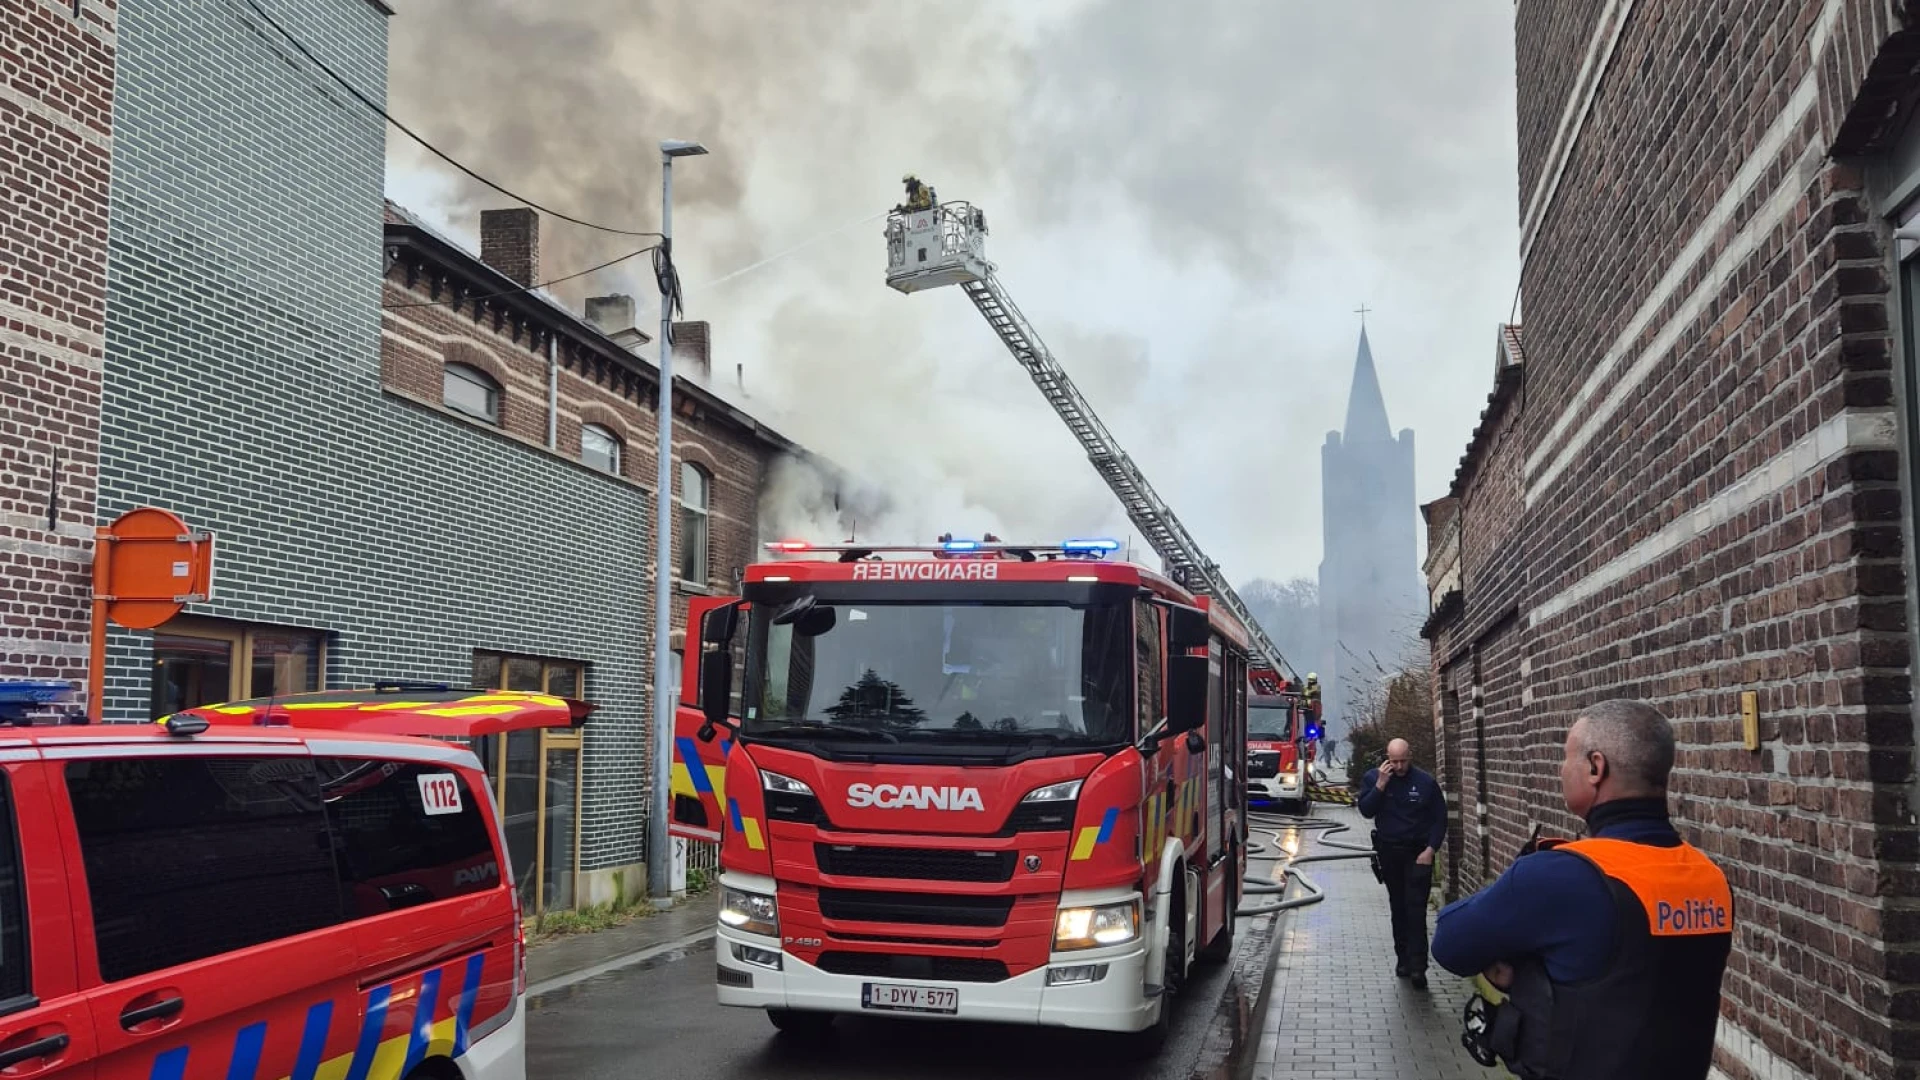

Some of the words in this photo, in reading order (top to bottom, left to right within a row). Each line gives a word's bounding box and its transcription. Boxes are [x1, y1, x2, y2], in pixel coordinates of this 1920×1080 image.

[430, 780, 458, 808] 112
[847, 782, 985, 812] SCANIA
[1658, 899, 1726, 931] Politie
[784, 936, 793, 945] P
